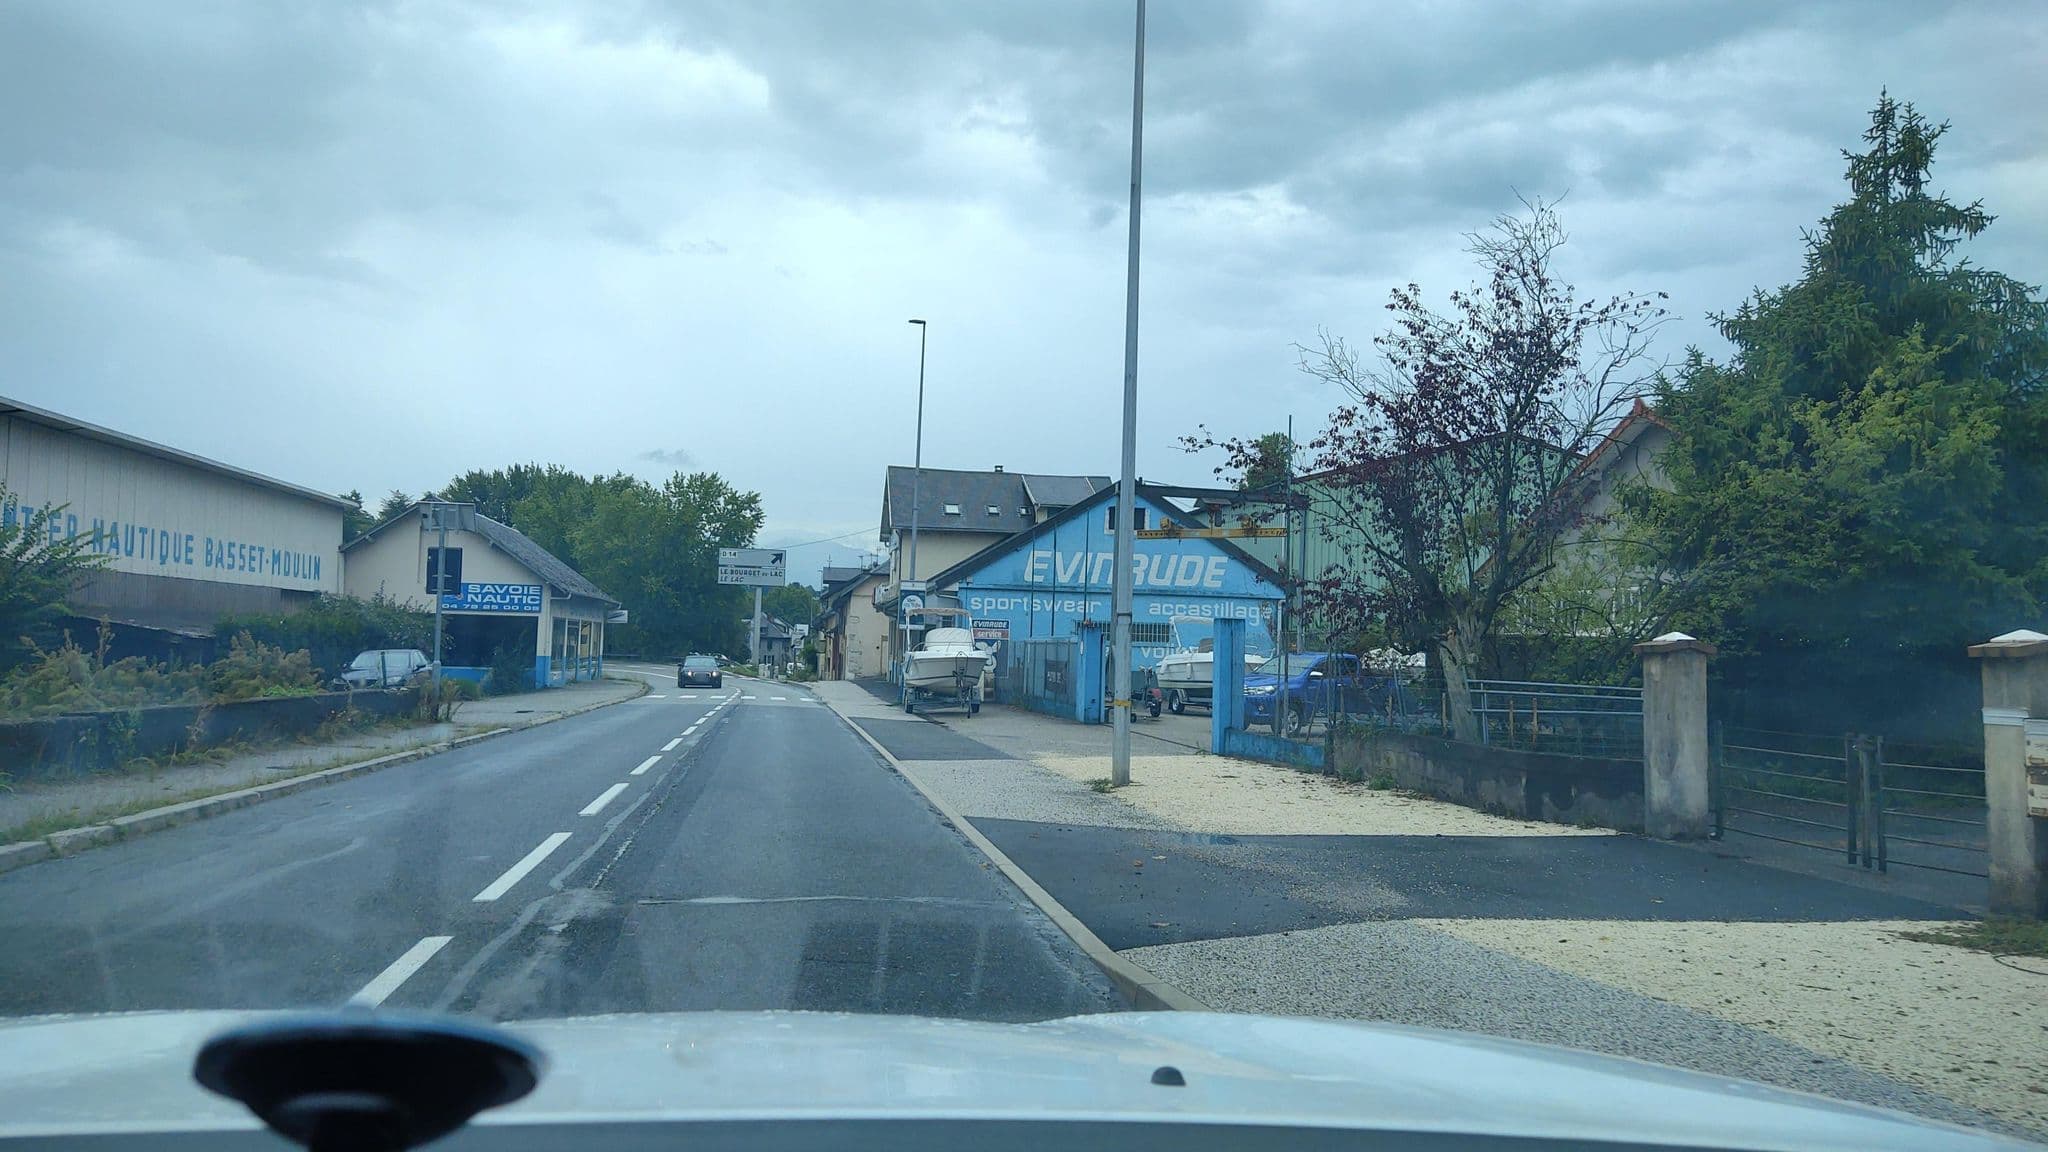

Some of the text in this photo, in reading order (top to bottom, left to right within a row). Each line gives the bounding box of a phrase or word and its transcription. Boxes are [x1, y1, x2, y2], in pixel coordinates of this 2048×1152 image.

[93, 517, 193, 565] NAUTIQUE
[1024, 550, 1228, 588] EVINRUDE
[468, 584, 541, 594] SAVOIE
[467, 594, 540, 604] NAUTIC
[970, 597, 1101, 616] sportswear
[973, 620, 1008, 628] EVINRUDE
